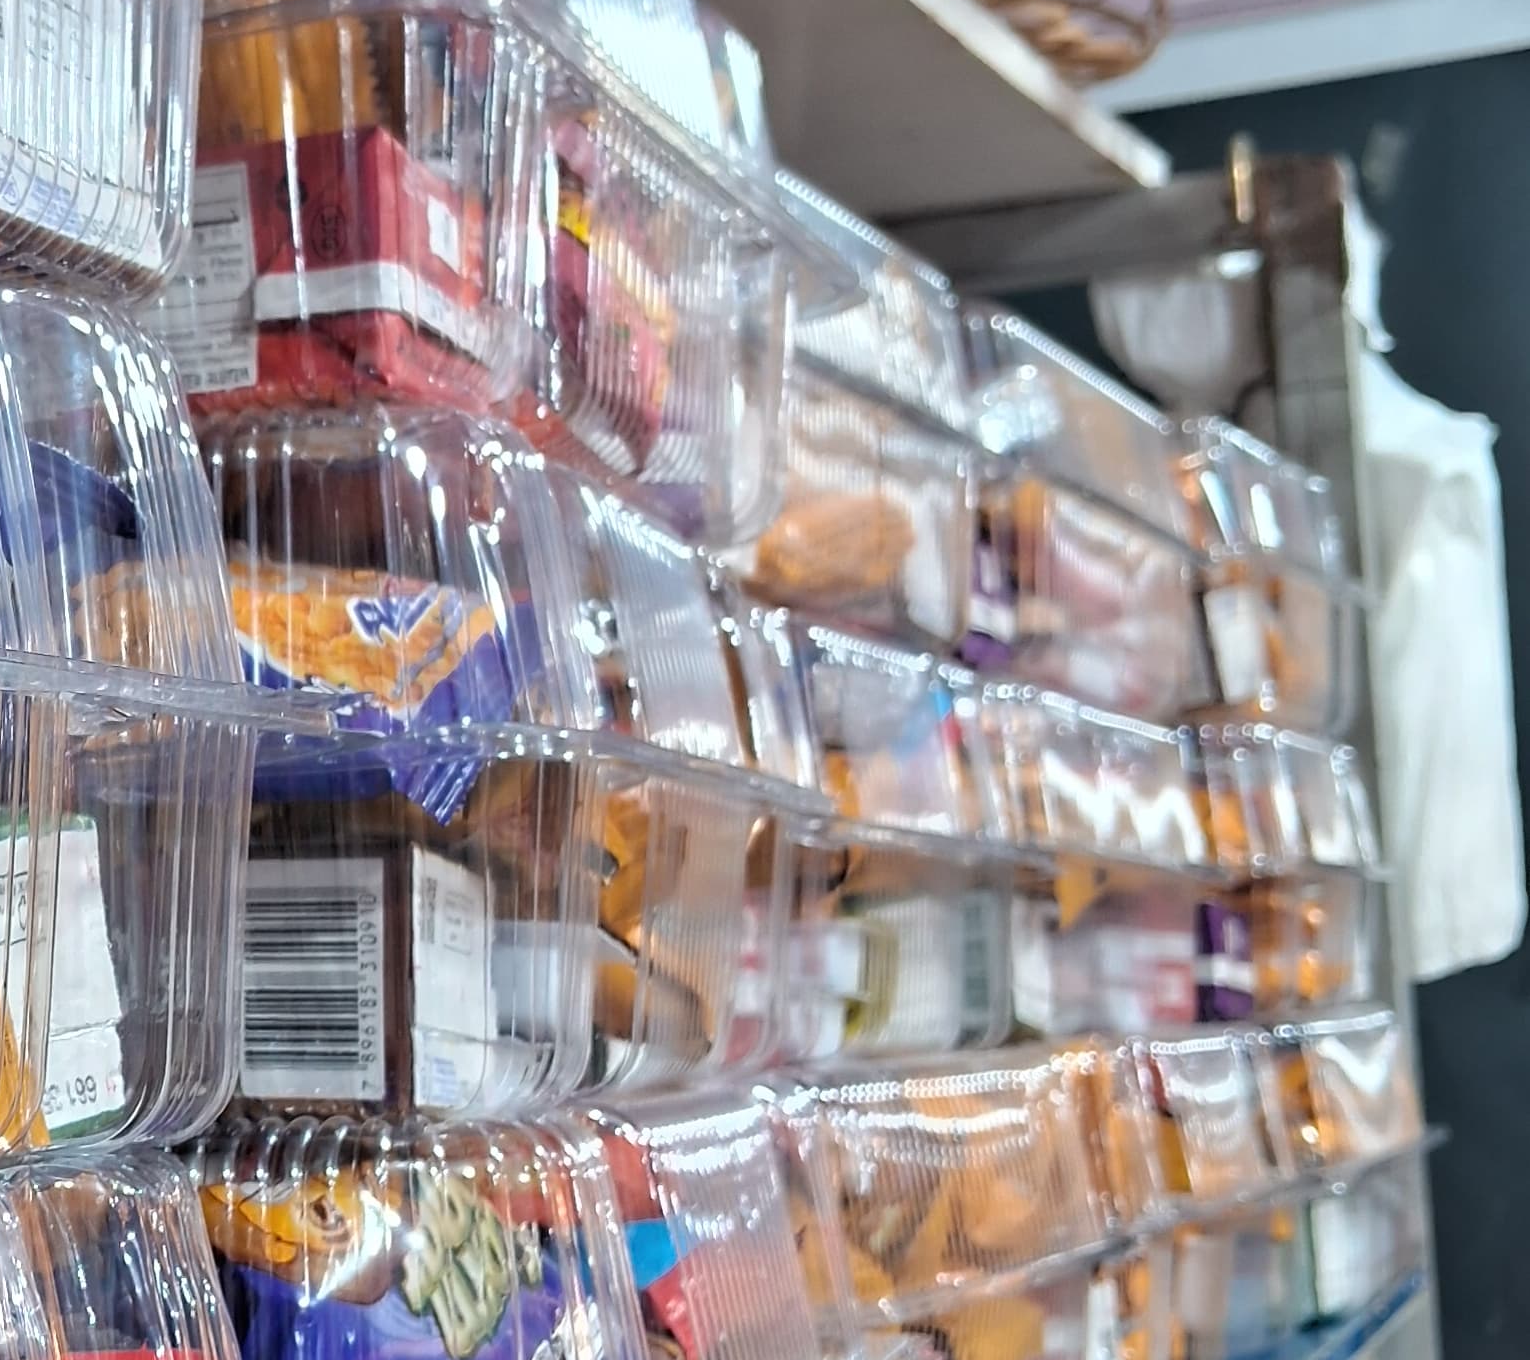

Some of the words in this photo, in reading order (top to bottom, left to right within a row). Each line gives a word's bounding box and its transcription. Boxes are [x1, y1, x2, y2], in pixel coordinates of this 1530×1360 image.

[359, 893, 378, 973] 310910
[359, 984, 378, 1064] 896185
[361, 1079, 377, 1092] 7
